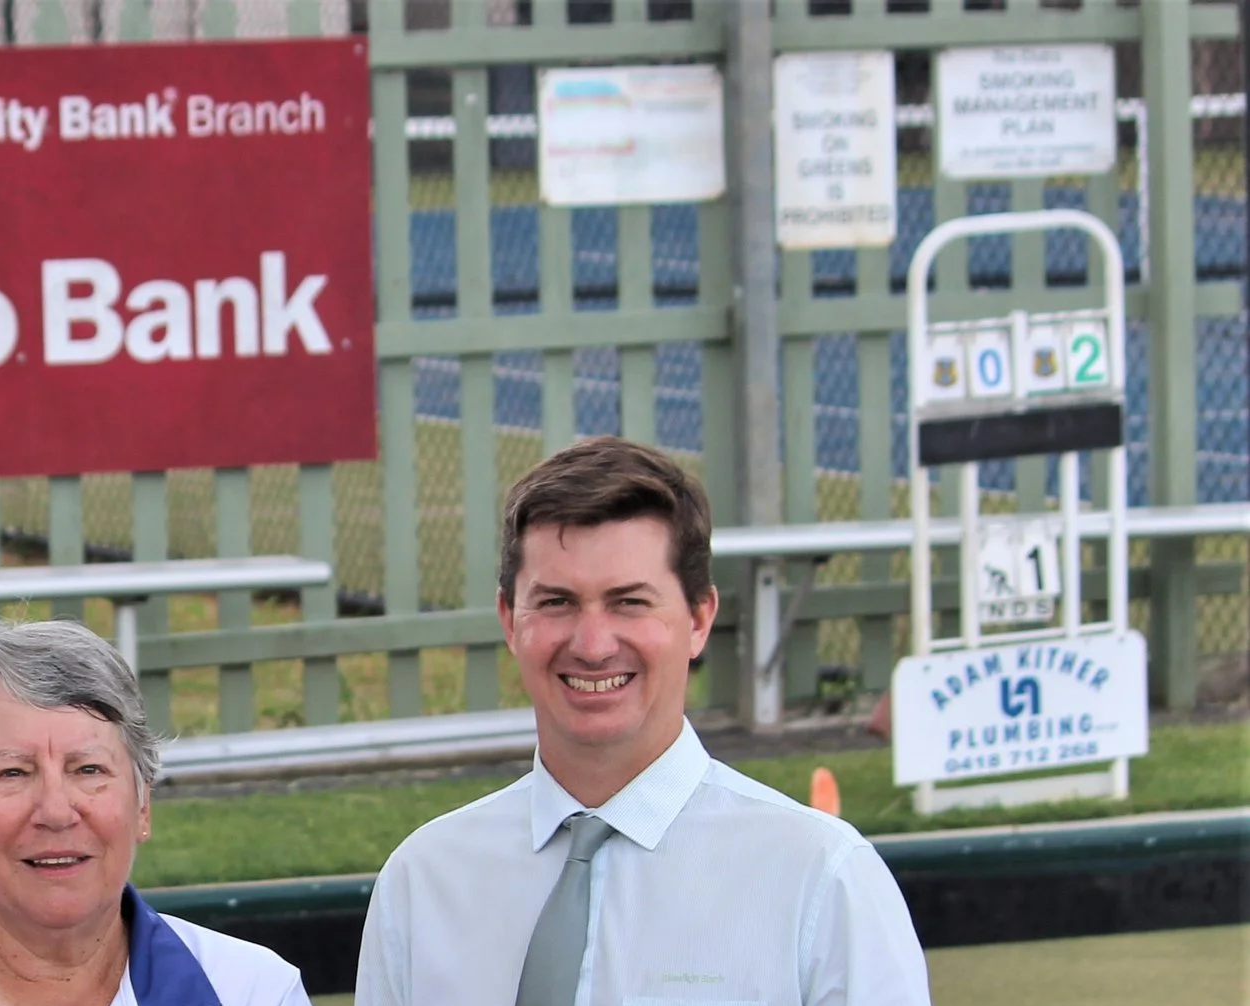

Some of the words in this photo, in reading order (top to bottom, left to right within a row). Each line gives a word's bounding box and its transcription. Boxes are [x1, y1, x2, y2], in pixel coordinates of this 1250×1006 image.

[979, 69, 1076, 90] SMOKING
[953, 91, 1099, 115] MANAGEMENT
[187, 93, 325, 138] Branch
[792, 108, 878, 130] SMOKING
[1001, 117, 1055, 137] PLAN
[821, 133, 849, 153] ON
[797, 156, 872, 178] GREENS
[780, 205, 890, 224] PROHIBITED
[42, 250, 332, 366] Bank
[1070, 333, 1106, 383] 2
[931, 652, 1002, 712] ADAM
[1017, 647, 1109, 691] KITHER
[949, 714, 1094, 750] PLUMBING
[1010, 747, 1050, 765] 712
